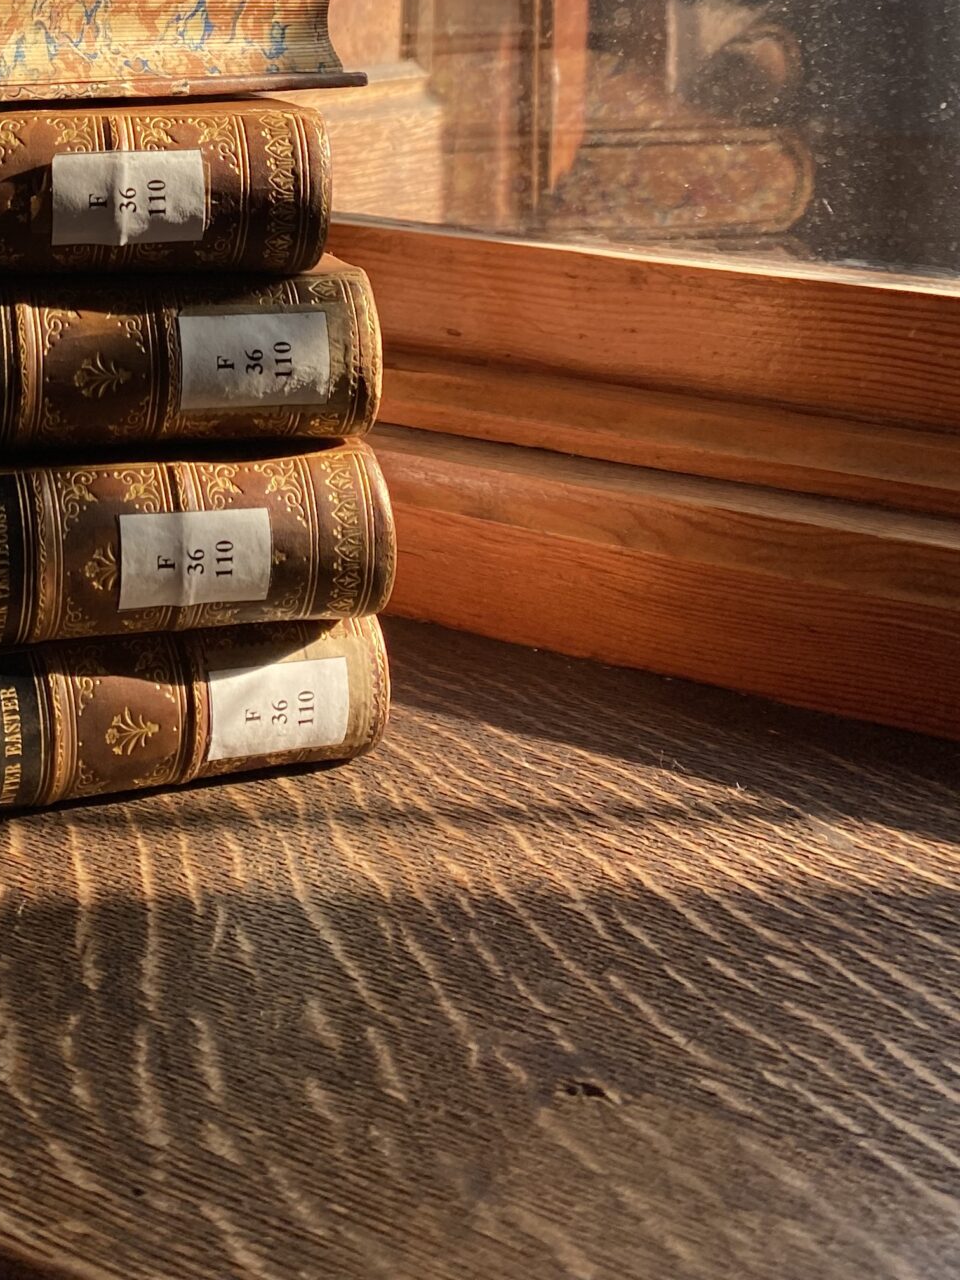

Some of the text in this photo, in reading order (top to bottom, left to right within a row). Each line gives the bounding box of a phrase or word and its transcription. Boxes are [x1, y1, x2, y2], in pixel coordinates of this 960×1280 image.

[87, 193, 108, 209] F
[119, 187, 137, 213] 36
[146, 179, 167, 217] 110
[216, 355, 235, 371] F
[244, 349, 264, 375] 36
[273, 341, 292, 378] 110
[157, 554, 176, 571] F
[186, 548, 205, 575] 36
[215, 540, 234, 577] 110
[0, 686, 23, 758] EASTER
[244, 707, 262, 725] F
[270, 699, 289, 726] 36
[298, 690, 315, 727] 110
